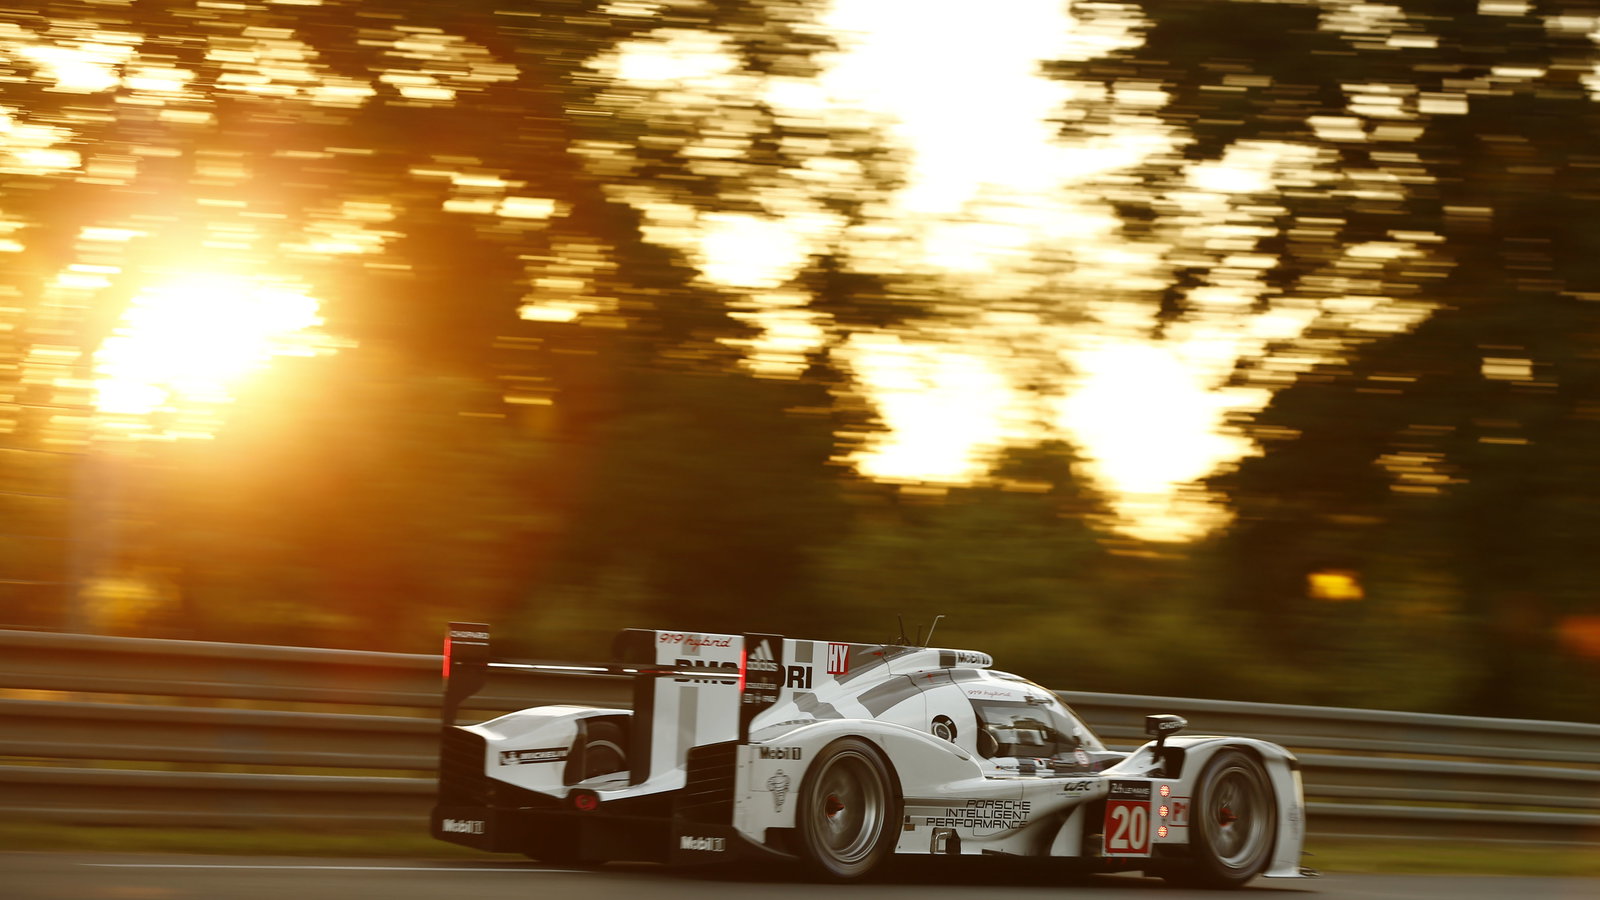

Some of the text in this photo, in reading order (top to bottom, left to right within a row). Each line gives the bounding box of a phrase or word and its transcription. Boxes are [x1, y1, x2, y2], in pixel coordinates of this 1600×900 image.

[659, 633, 733, 652] 919 hybrid
[828, 644, 848, 673] HY
[760, 746, 790, 760] Mobil
[1064, 781, 1092, 792] WEC
[966, 799, 1031, 811] PORSCHE
[946, 808, 1030, 820] INTELLIGENT
[443, 819, 472, 834] Mobil
[926, 817, 1028, 829] PERFORMANCE
[1109, 805, 1148, 850] 20
[680, 835, 712, 851] Mobil
